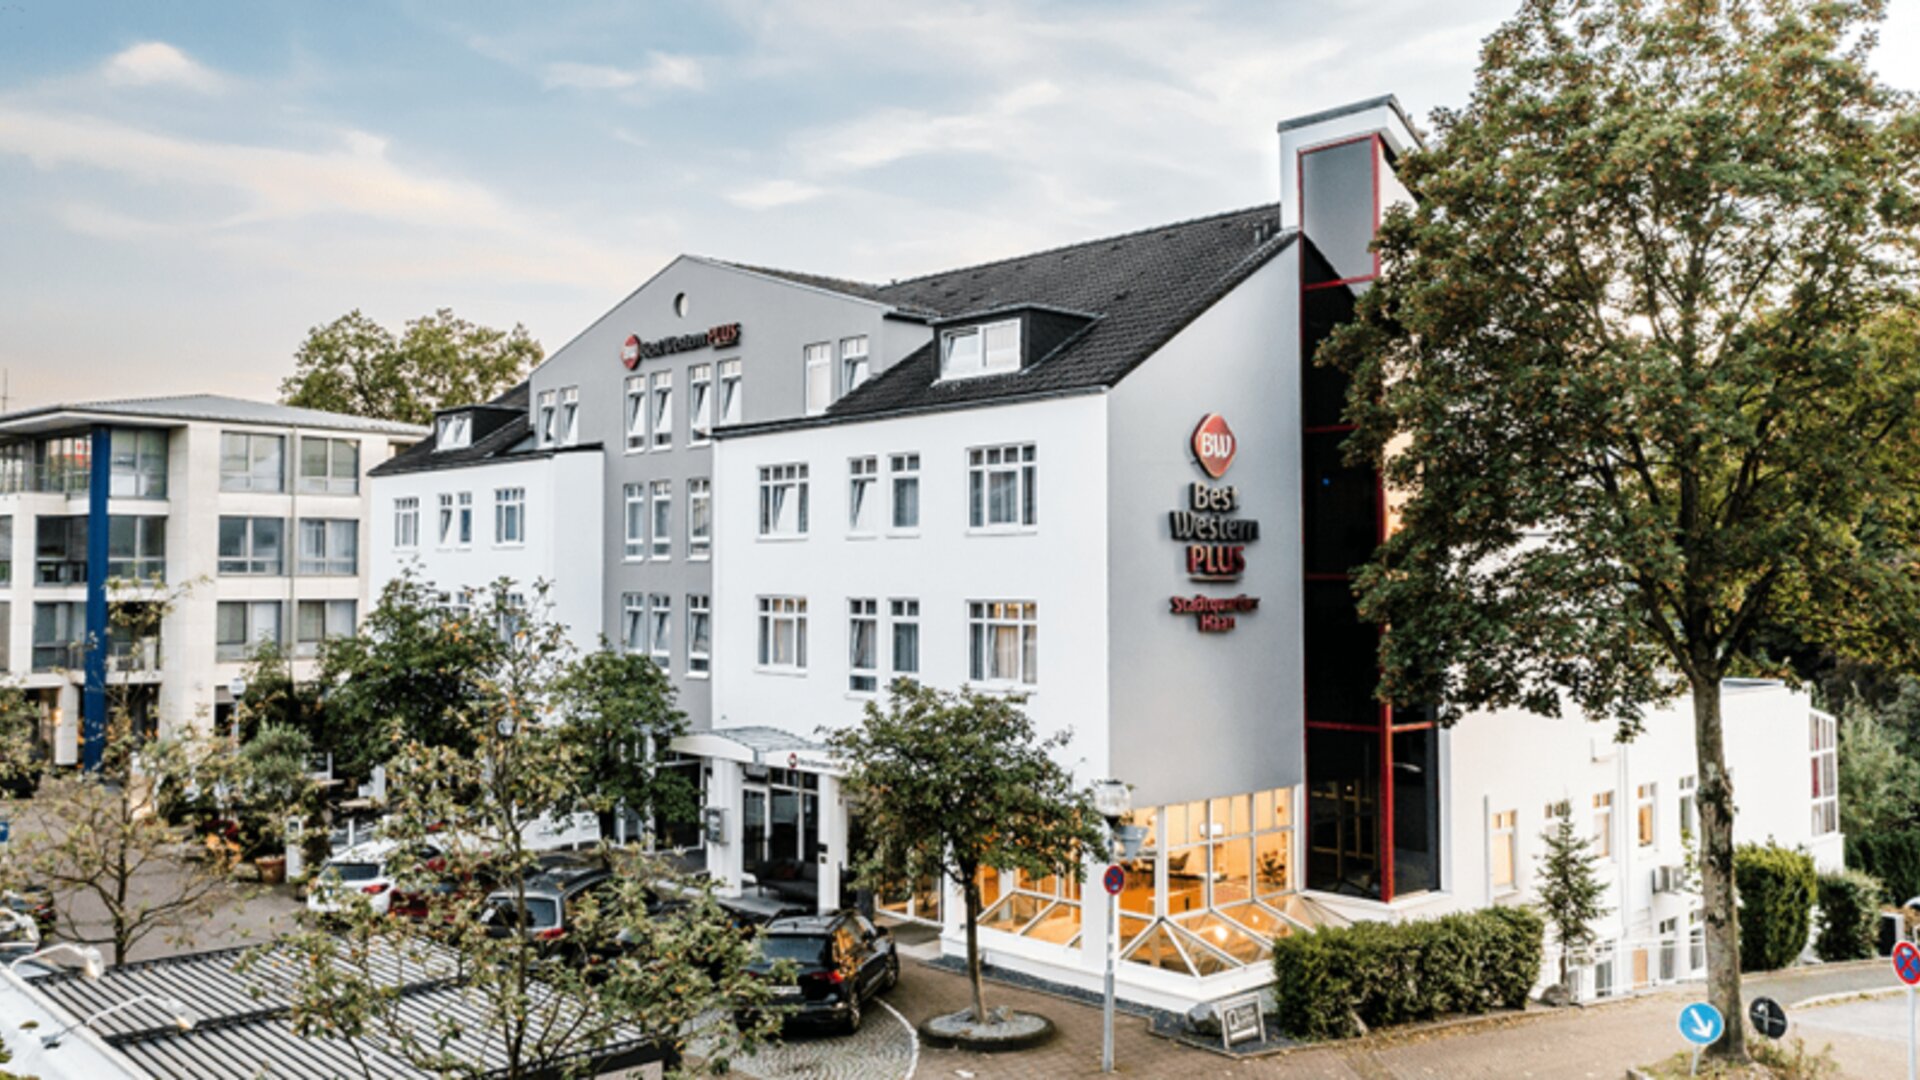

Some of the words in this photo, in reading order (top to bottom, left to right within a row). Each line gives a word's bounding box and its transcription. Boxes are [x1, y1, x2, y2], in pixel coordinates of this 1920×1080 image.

[708, 323, 741, 347] PLUS
[1201, 433, 1231, 457] BW
[1191, 480, 1239, 511] Best
[1170, 511, 1259, 541] Western
[1187, 545, 1246, 574] PLUS
